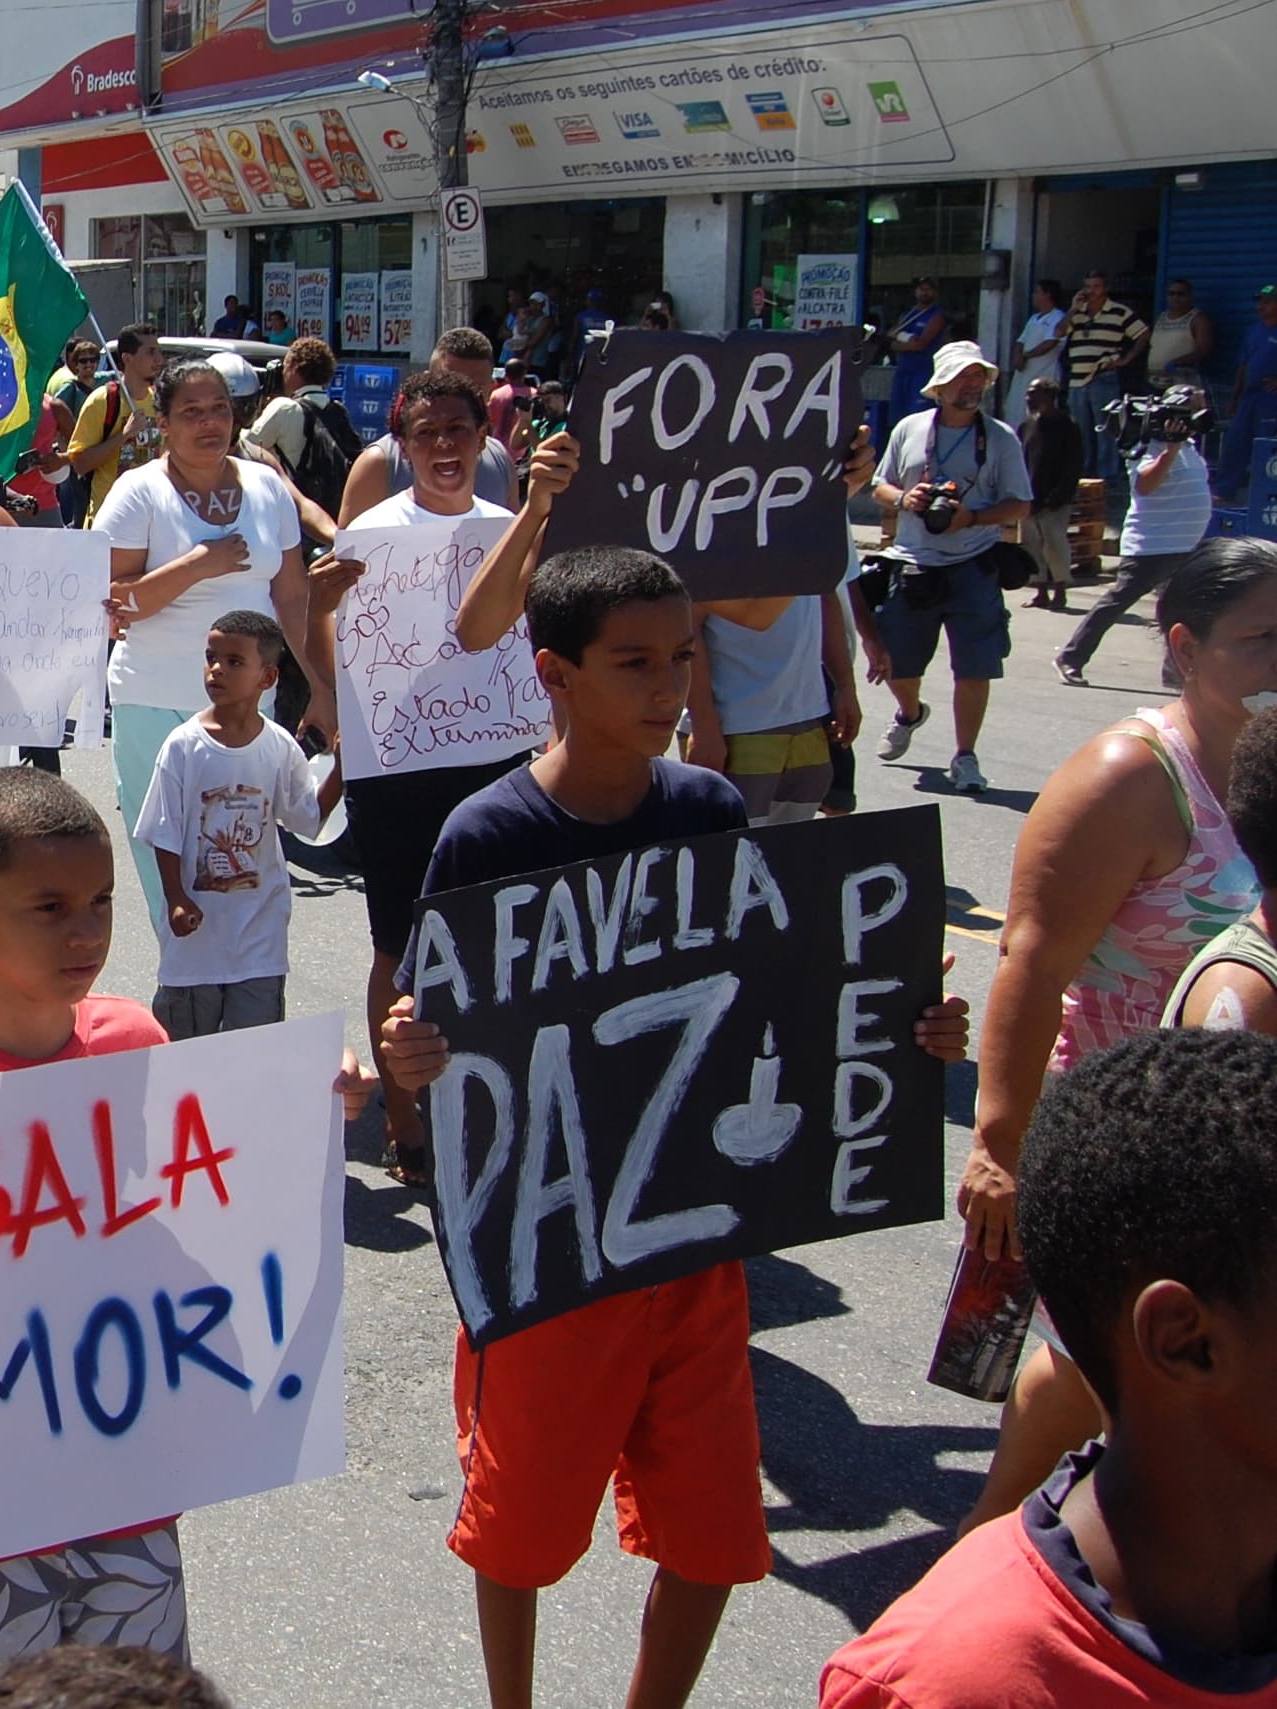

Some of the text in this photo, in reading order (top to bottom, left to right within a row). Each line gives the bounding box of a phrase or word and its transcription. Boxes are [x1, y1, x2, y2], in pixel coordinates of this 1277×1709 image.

[479, 57, 828, 110] Aceitamos os seguintes cartões de crédito:
[621, 112, 654, 129] VISA
[599, 349, 842, 465] FORA
[372, 683, 491, 736] Estado
[413, 837, 790, 1020] A FAVELA
[430, 970, 742, 1338] PAZ
